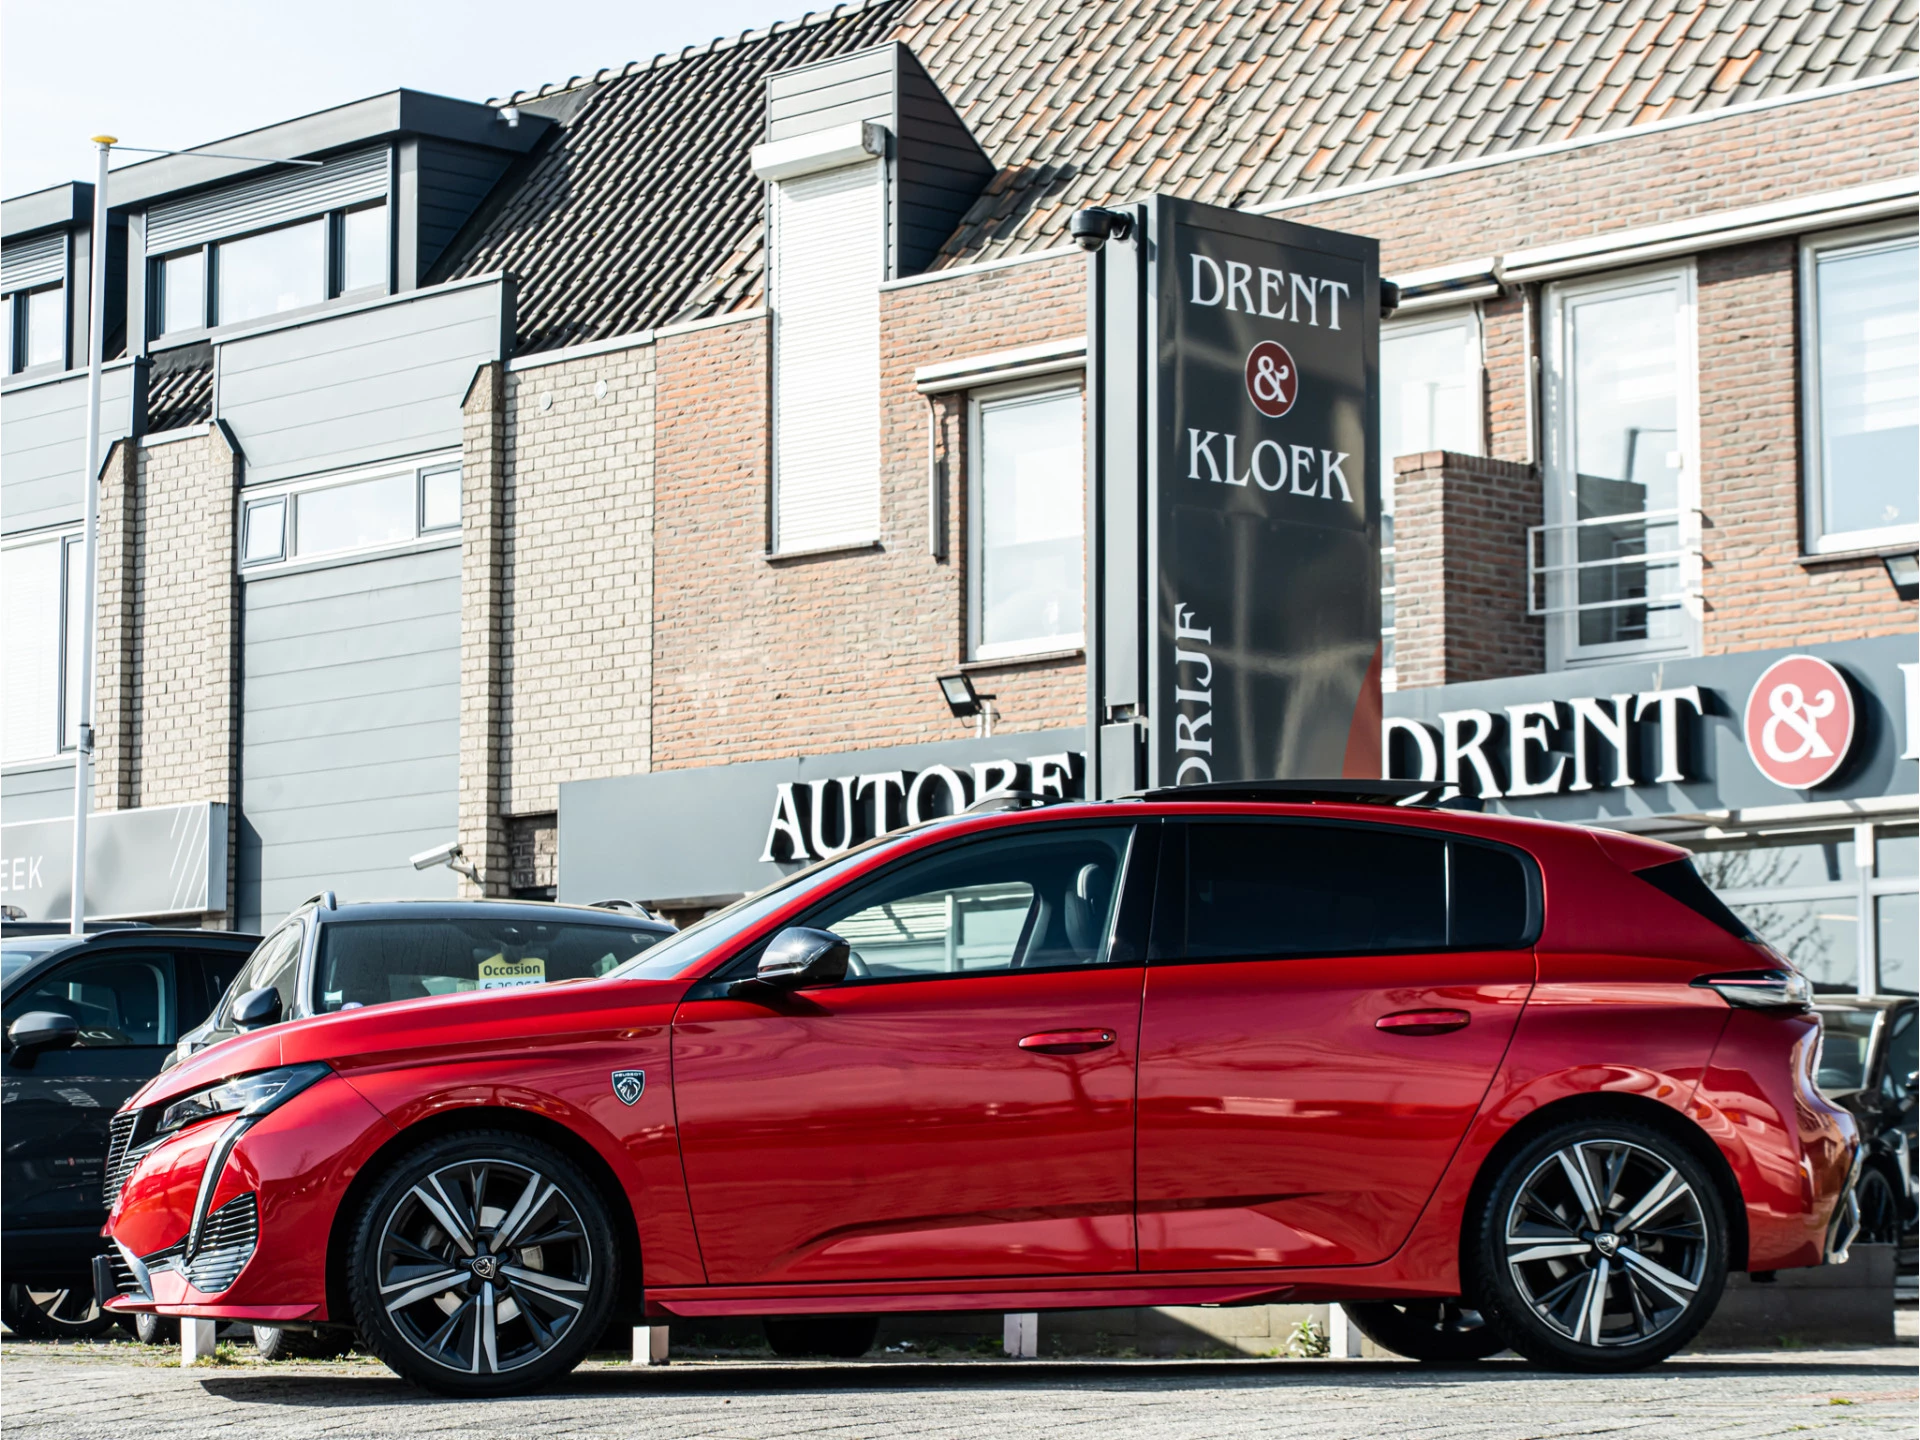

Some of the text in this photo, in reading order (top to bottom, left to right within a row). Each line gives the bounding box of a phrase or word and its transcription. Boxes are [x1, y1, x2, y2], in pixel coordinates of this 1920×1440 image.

[1190, 253, 1349, 331] DRENT
[1253, 355, 1290, 403] &
[1187, 428, 1354, 503] KLOEK
[1382, 685, 1703, 806] DRENT
[1762, 683, 1836, 763] &
[483, 963, 541, 976] Occasion
